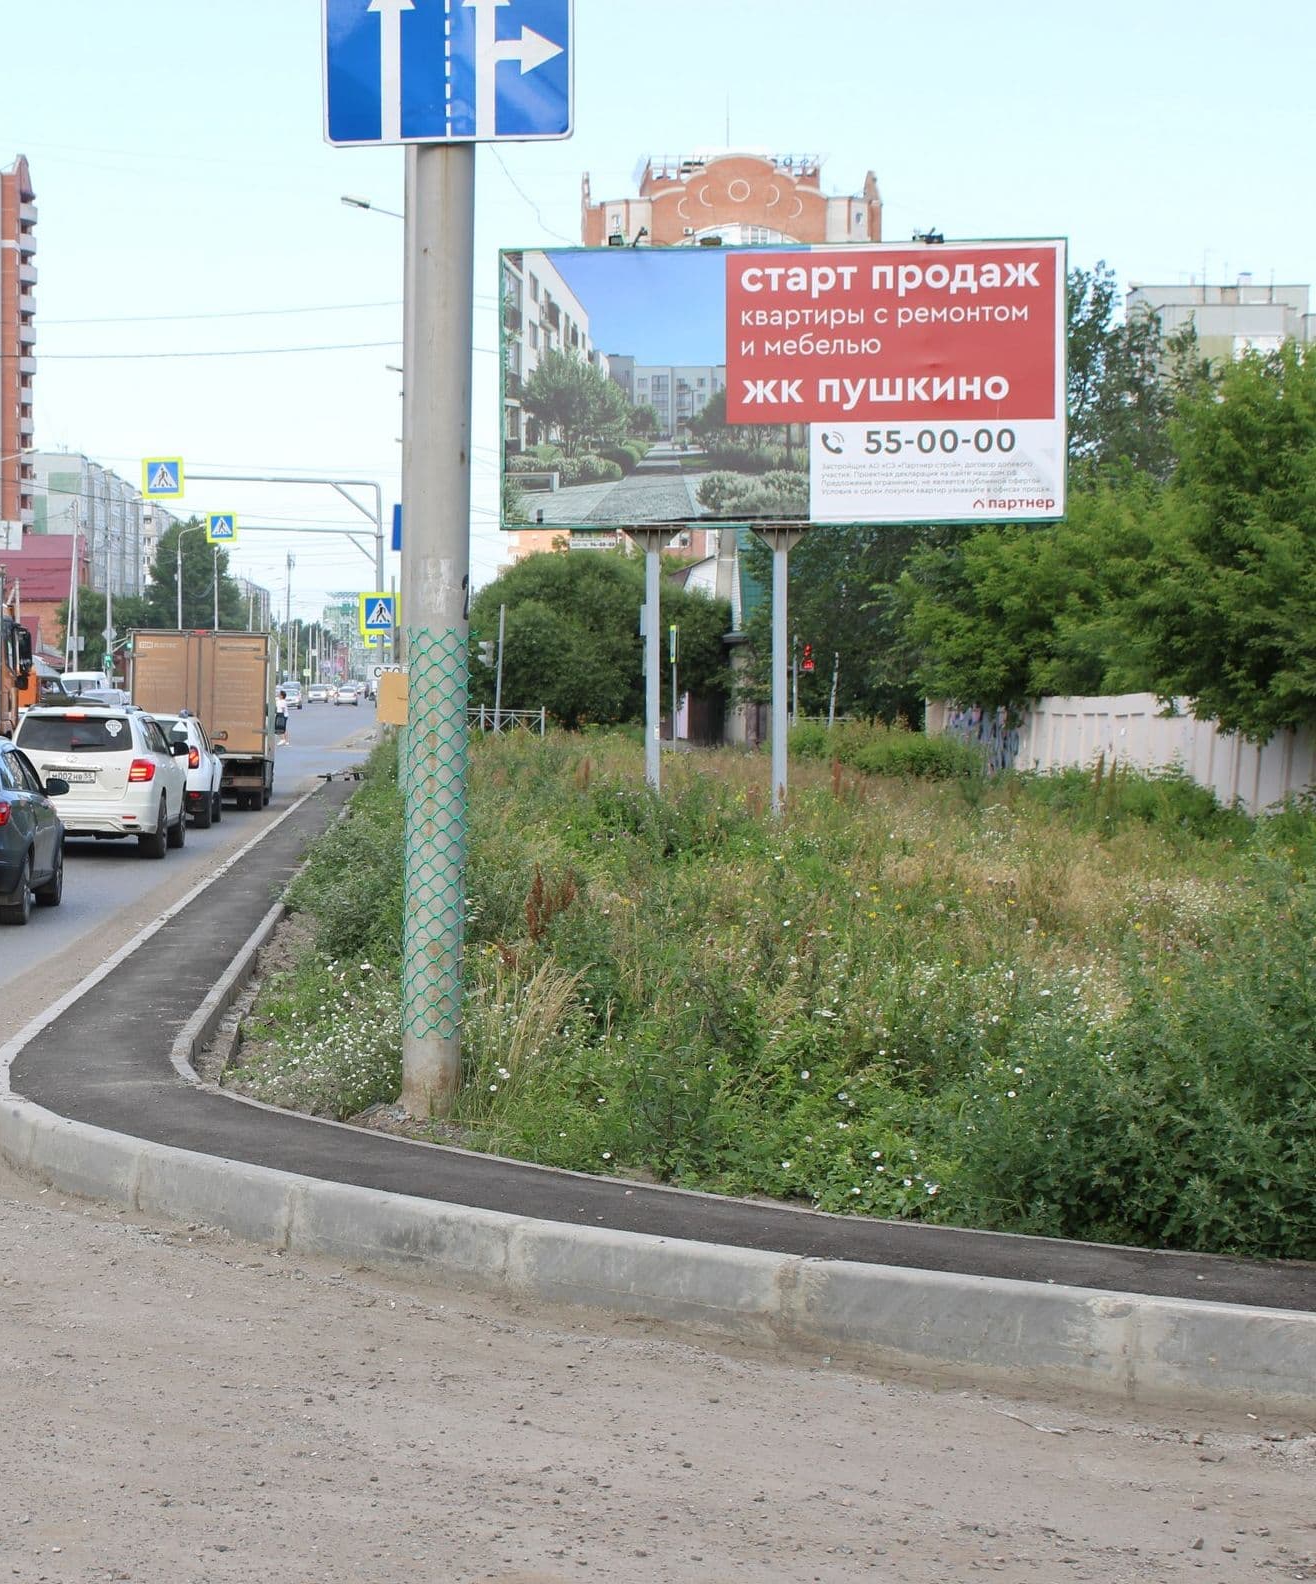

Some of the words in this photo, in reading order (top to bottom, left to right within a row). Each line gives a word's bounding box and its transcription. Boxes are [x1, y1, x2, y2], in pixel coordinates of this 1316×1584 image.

[741, 266, 858, 298] старт
[872, 262, 1040, 297] продаж
[741, 308, 864, 330] квартиры
[874, 308, 888, 324] с
[898, 305, 1028, 328] ремонтом
[741, 340, 754, 356] и
[765, 333, 881, 356] мебелью
[818, 376, 1010, 410] пушкино
[865, 428, 1016, 454] 55-00-00
[989, 498, 1055, 511] партнер
